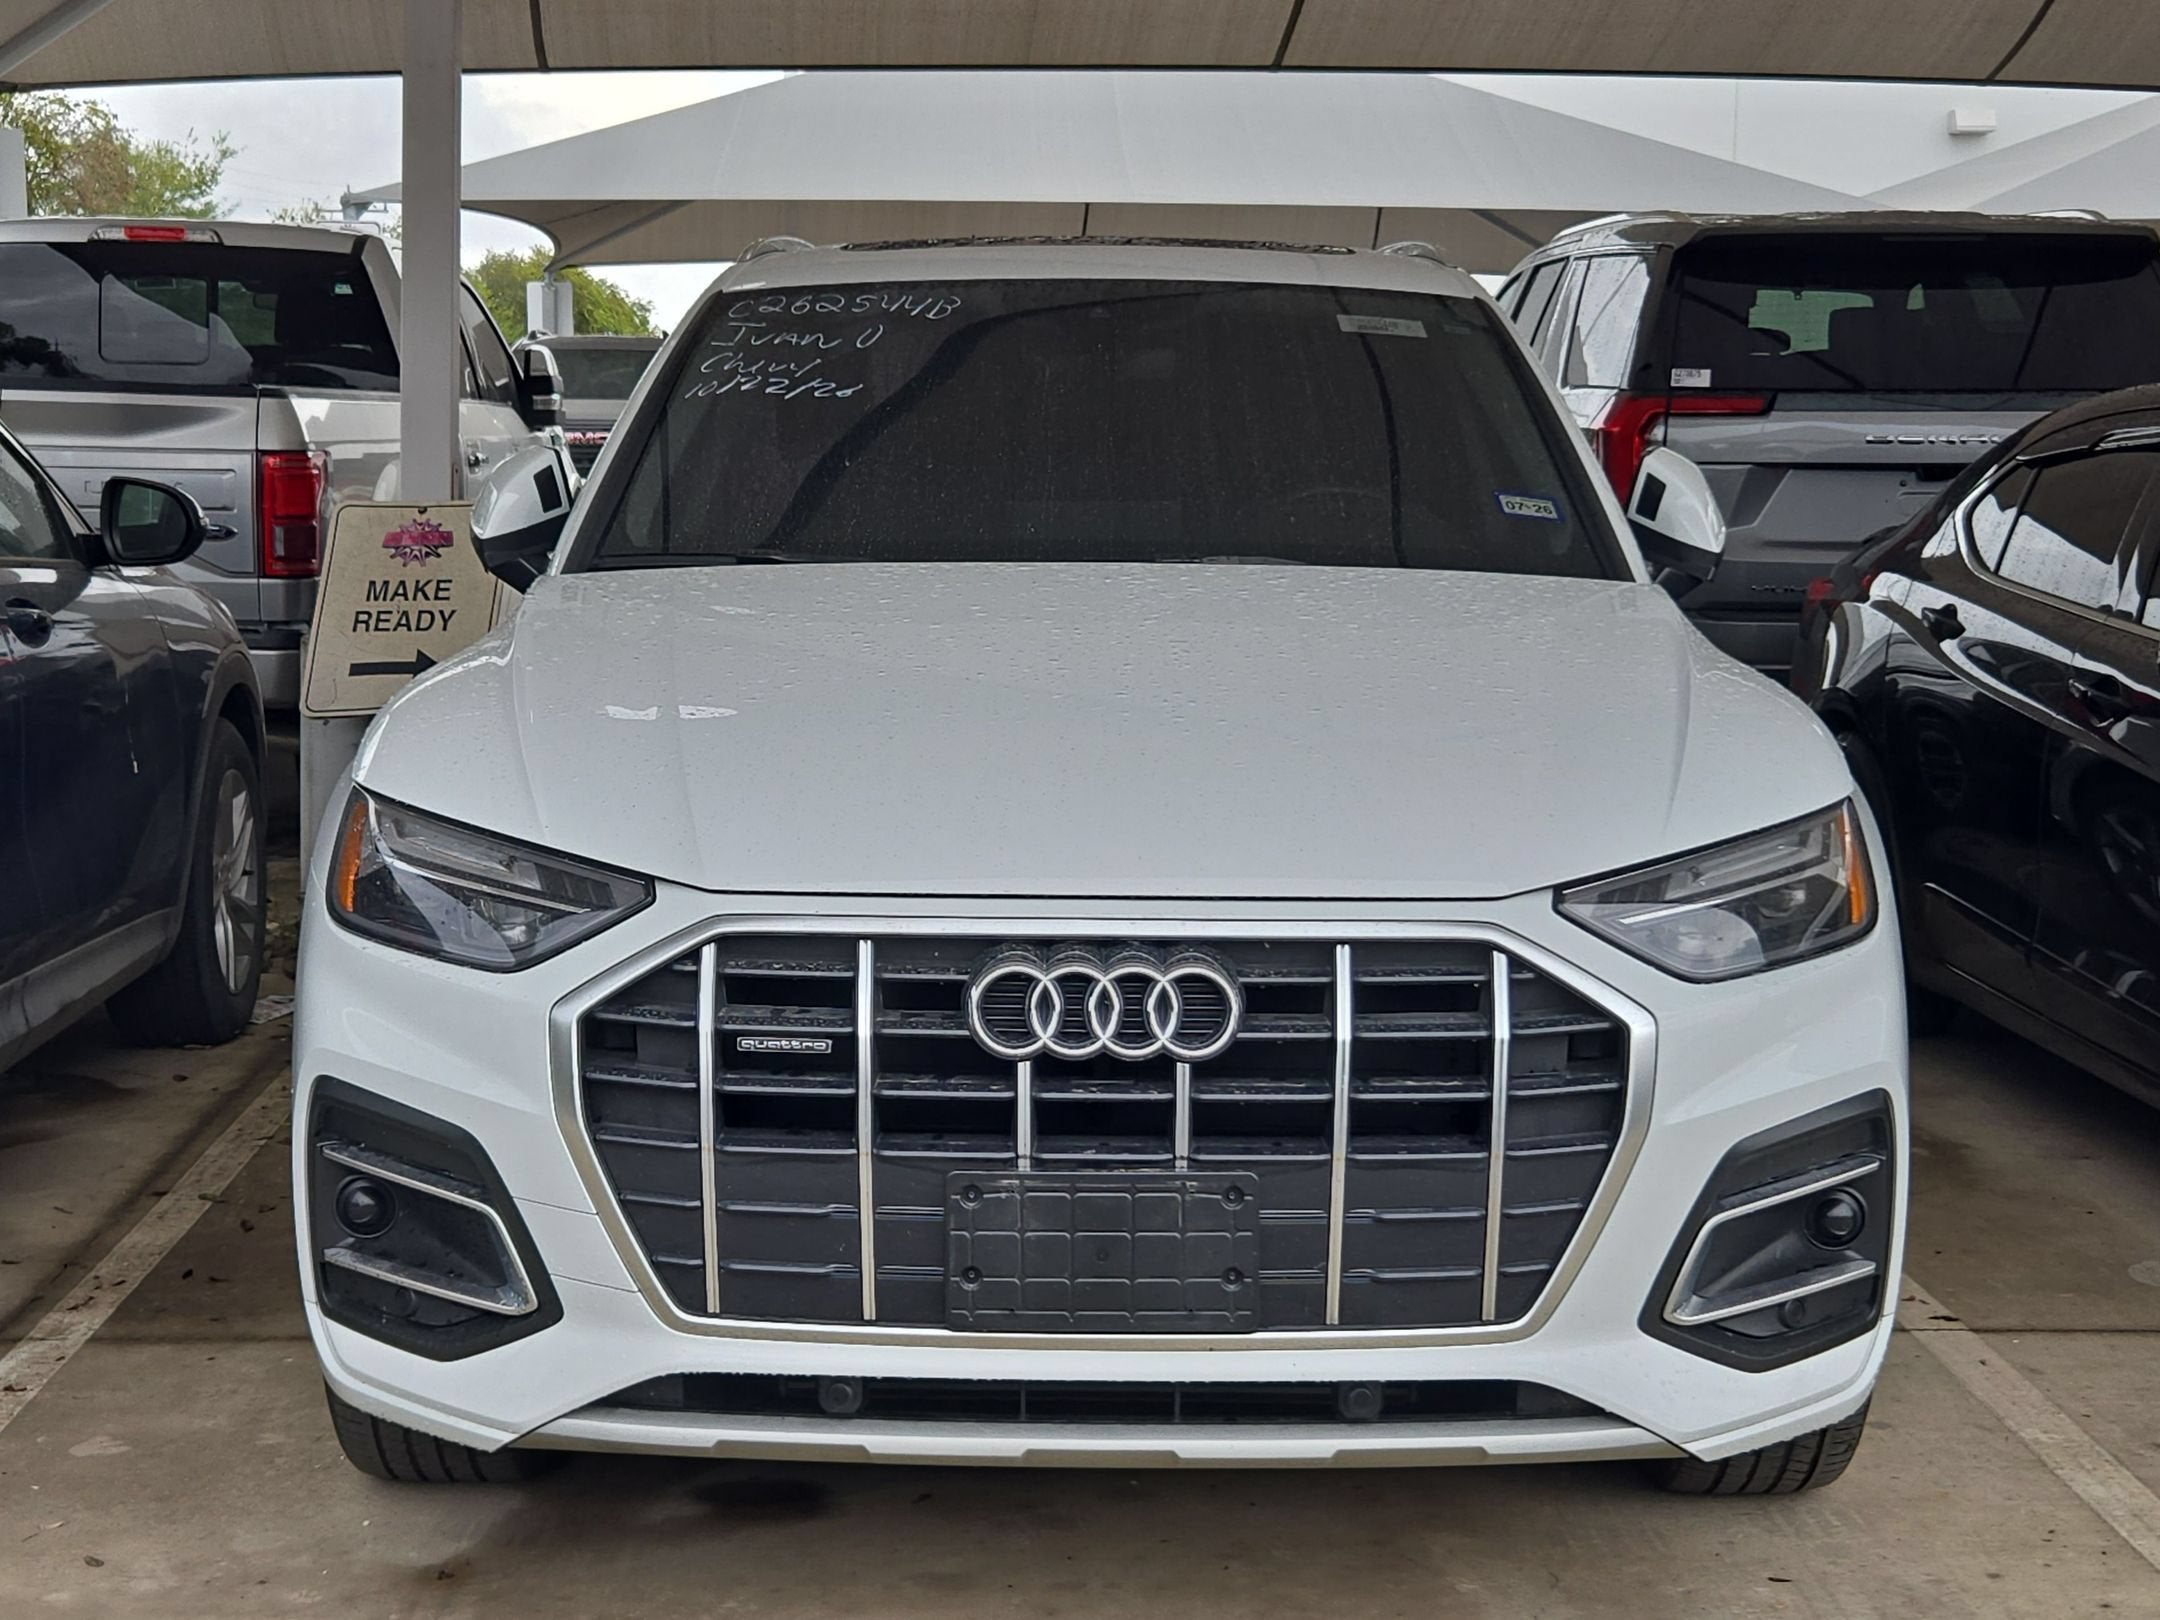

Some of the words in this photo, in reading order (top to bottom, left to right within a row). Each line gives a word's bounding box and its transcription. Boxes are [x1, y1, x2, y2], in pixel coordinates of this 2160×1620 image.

[366, 579, 453, 602] MAKE
[352, 609, 457, 632] READY
[740, 1039, 827, 1051] quattro
